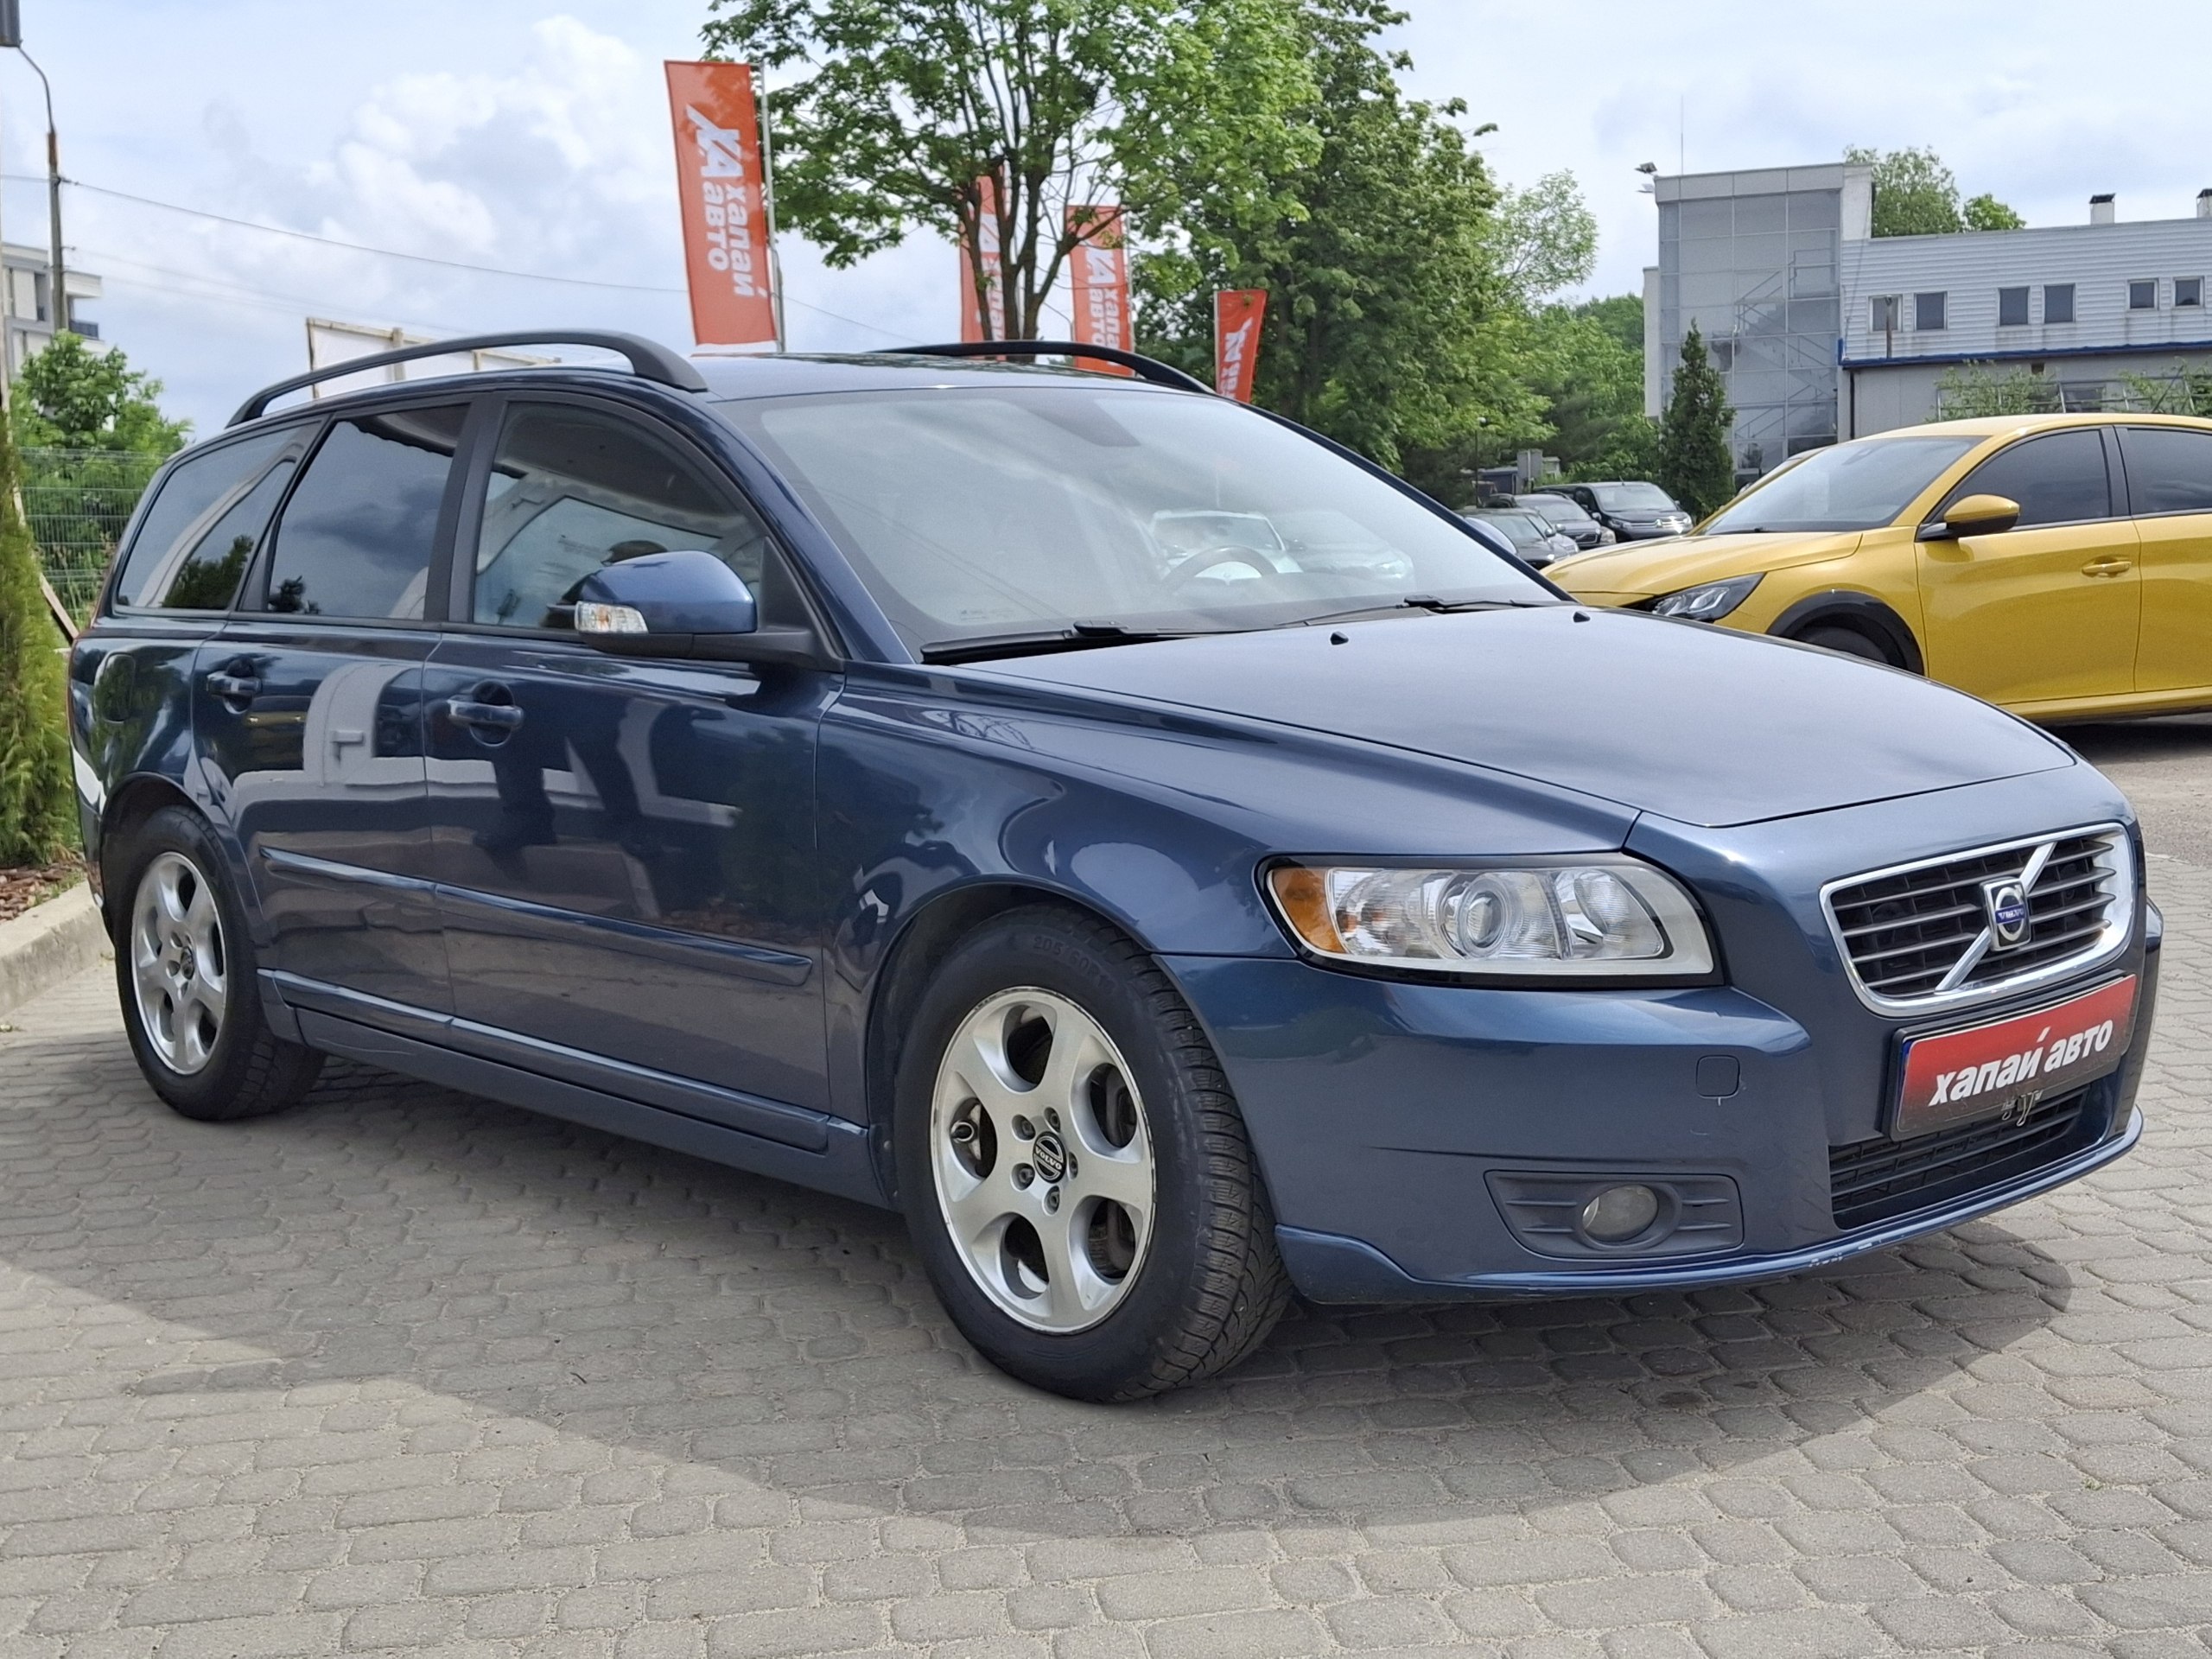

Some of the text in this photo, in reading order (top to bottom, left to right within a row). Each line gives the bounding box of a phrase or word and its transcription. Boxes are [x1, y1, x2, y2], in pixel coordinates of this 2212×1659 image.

[702, 181, 729, 270] авто
[728, 184, 768, 298] хапай
[1104, 288, 1121, 351] хапа
[1928, 1020, 2114, 1107] хапай авто
[1035, 1145, 1063, 1170] VOLVO
